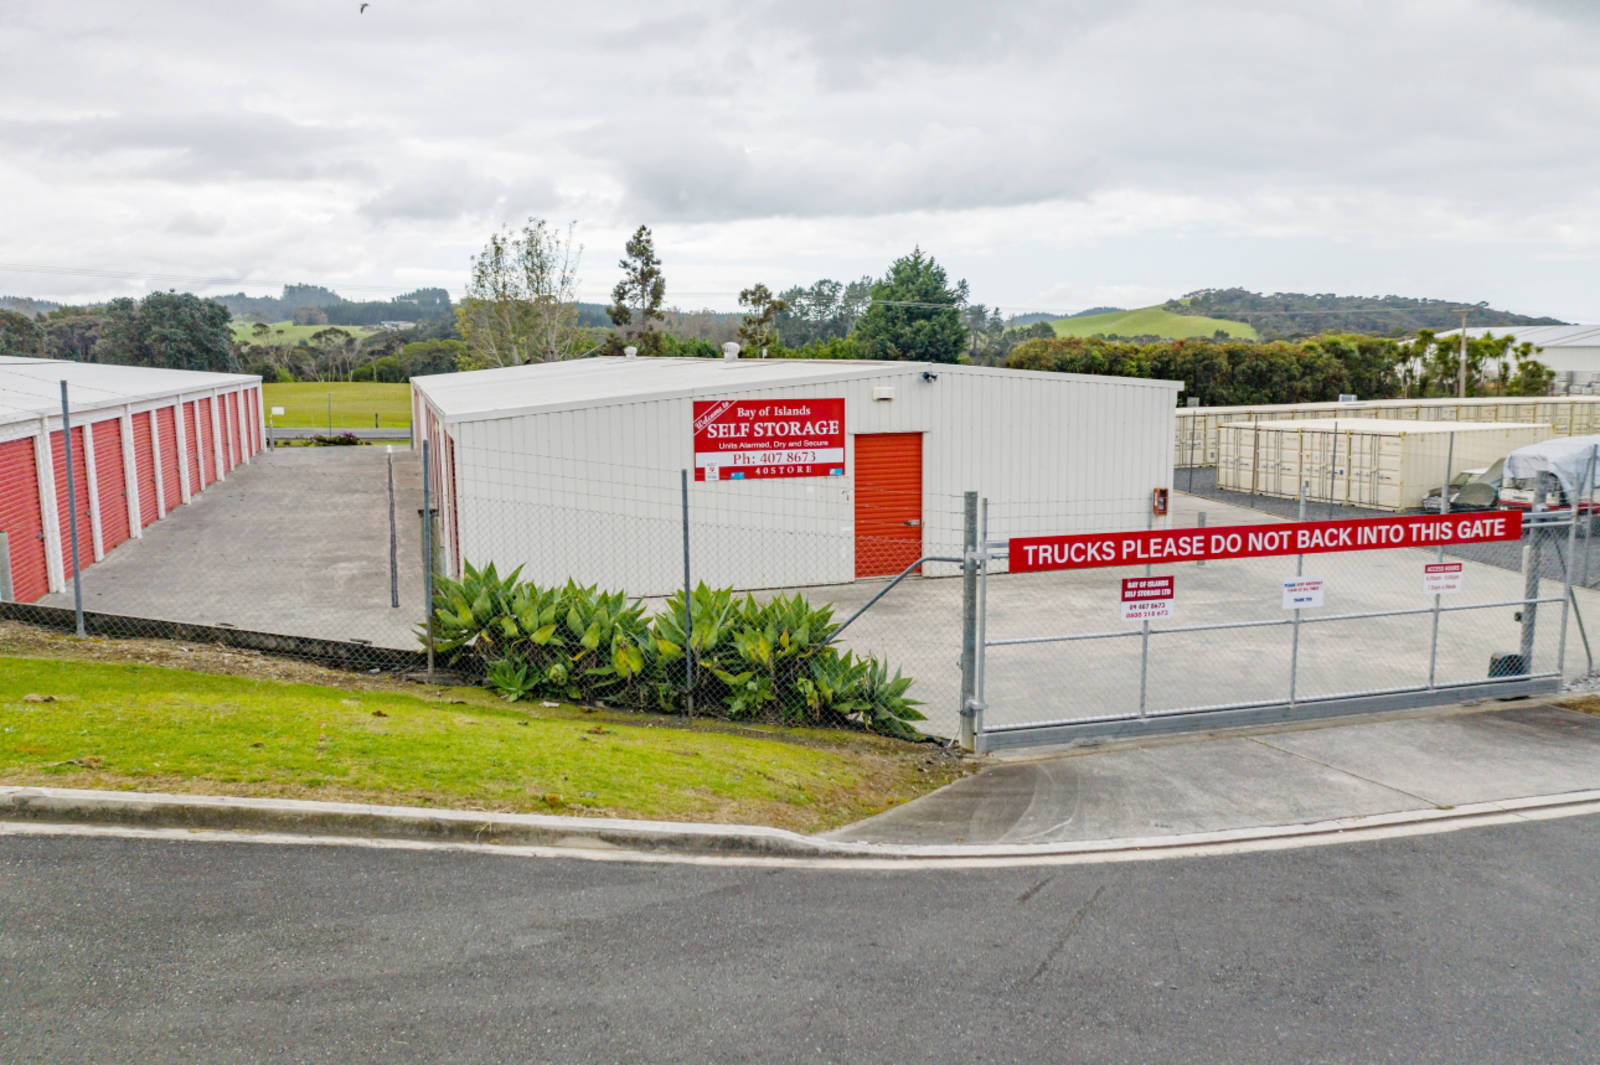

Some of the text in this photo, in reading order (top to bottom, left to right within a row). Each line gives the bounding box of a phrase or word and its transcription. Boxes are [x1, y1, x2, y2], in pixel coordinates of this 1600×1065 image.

[695, 407, 722, 429] Welcome
[737, 405, 811, 420] Bay of Islands
[707, 420, 840, 438] SELF STORAGE
[774, 441, 786, 449] Dry
[733, 451, 816, 465] Ph: 407 8673
[1023, 518, 1506, 566] TRUCKS PLEASE DO NOT BACK INTO THIS GATE
[1148, 580, 1169, 588] ISLANDS
[1137, 589, 1160, 598] STORAGE
